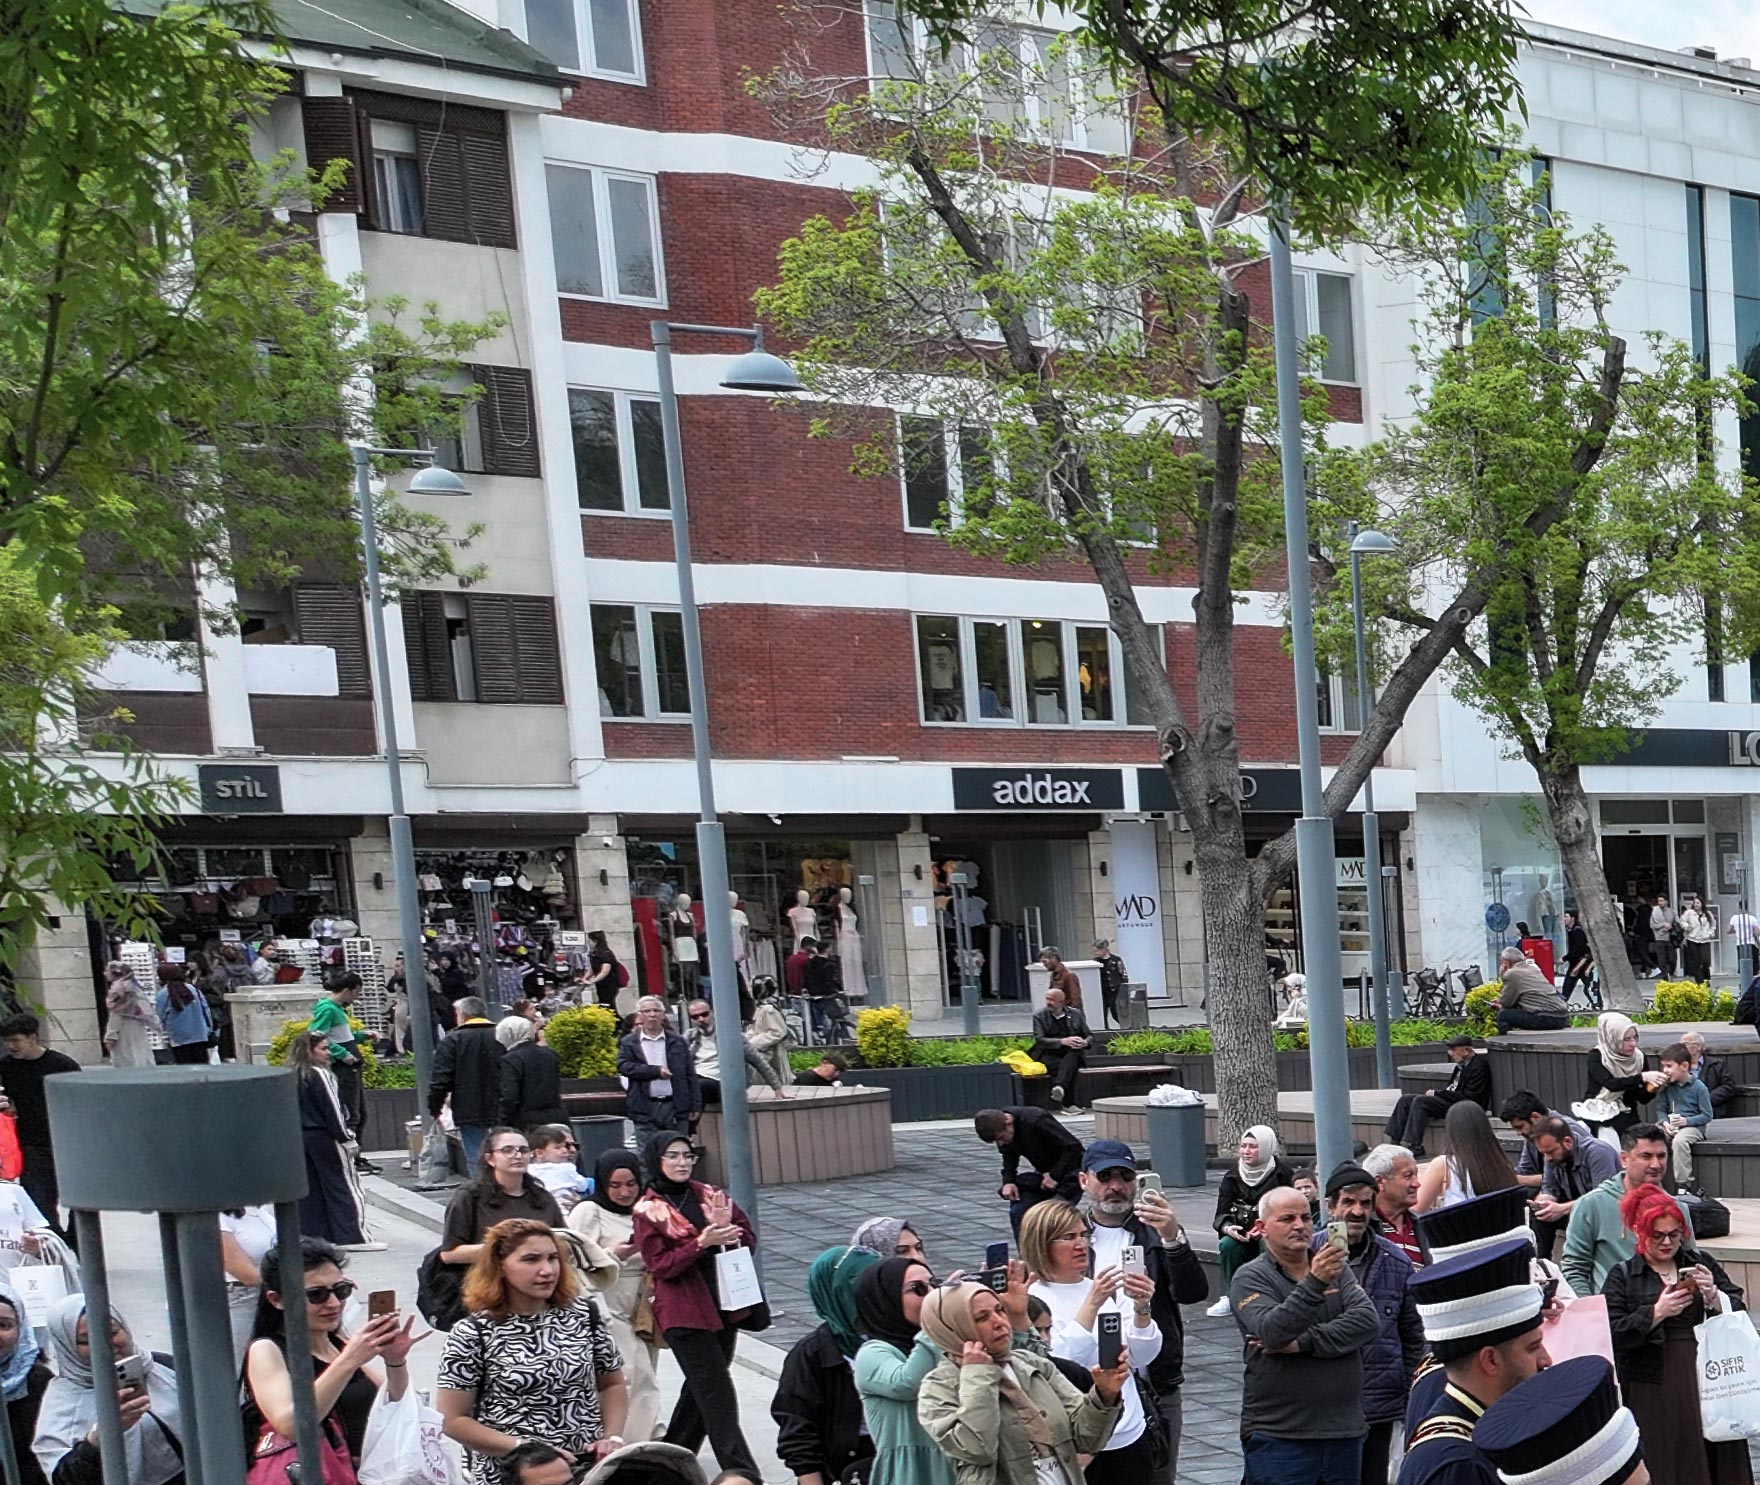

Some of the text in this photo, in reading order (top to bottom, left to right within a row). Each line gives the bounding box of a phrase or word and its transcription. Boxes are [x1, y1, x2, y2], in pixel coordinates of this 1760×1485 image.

[216, 776, 268, 798] STİL
[992, 773, 1092, 804] addax
[1720, 1355, 1744, 1368] SIFIR
[1723, 1365, 1746, 1376] ATIK
